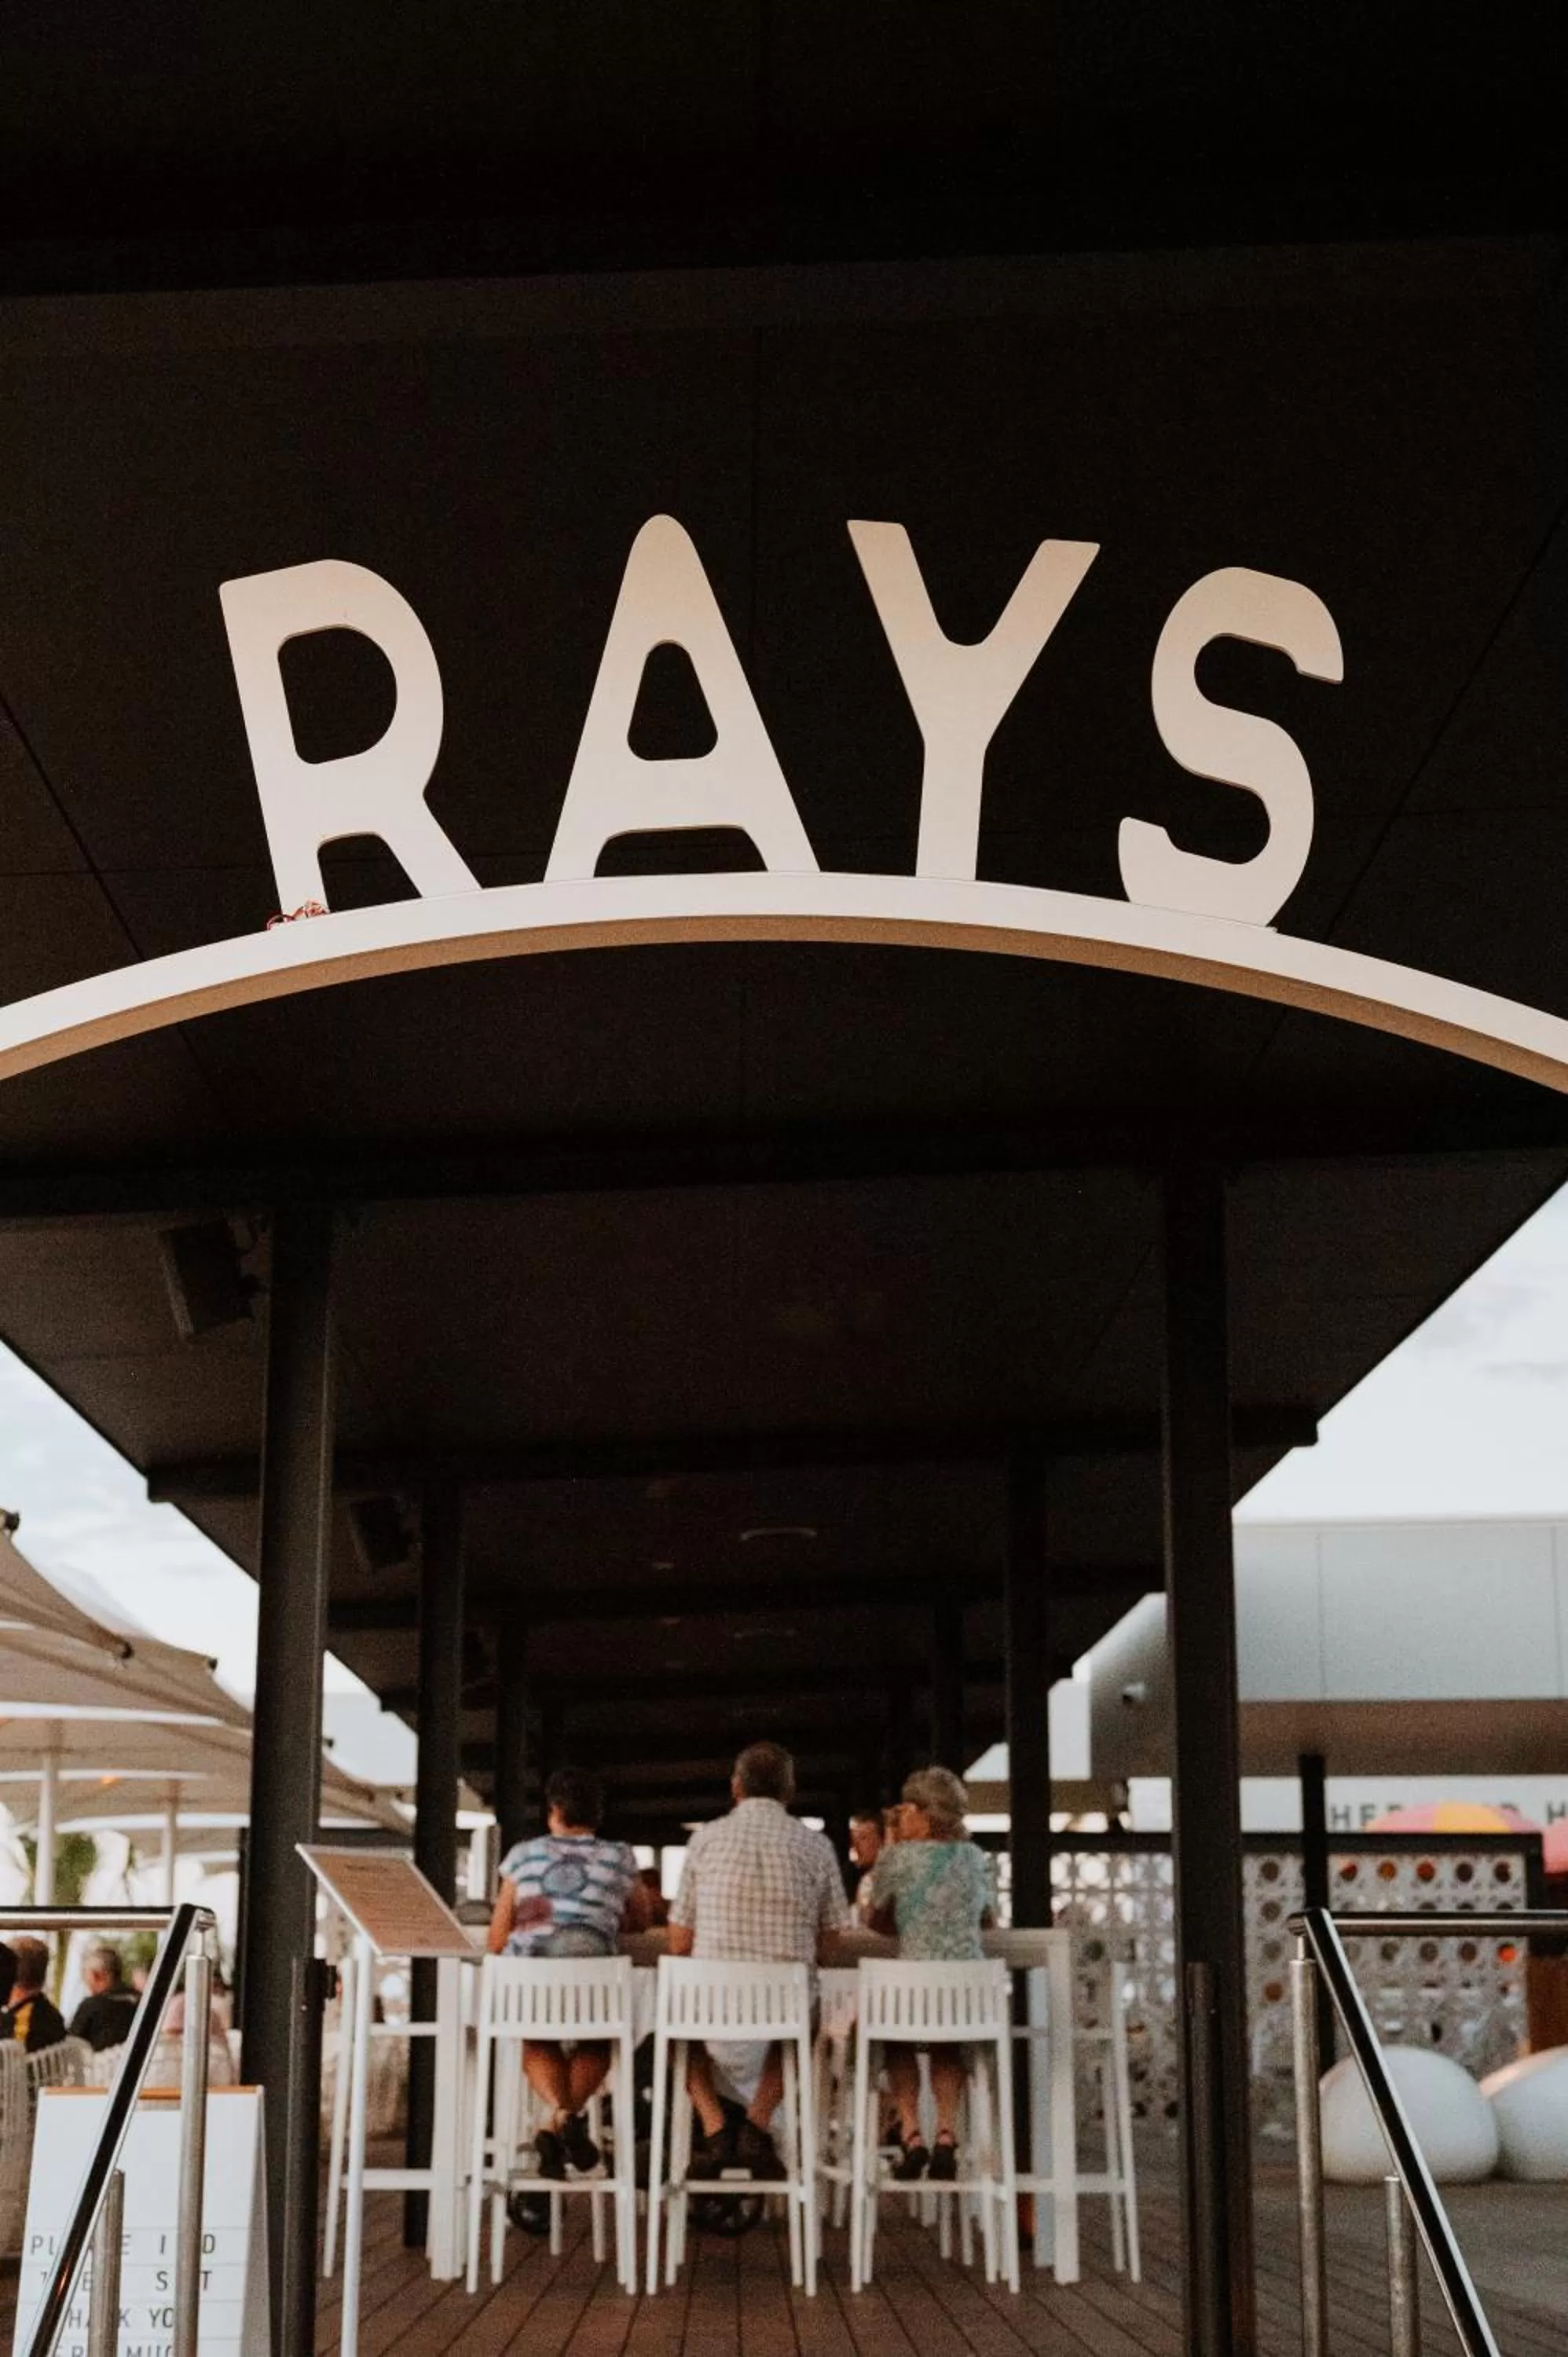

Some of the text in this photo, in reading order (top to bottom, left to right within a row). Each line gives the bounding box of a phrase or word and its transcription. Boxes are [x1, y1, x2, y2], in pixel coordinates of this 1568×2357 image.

[219, 514, 1344, 928] RAYS
[30, 2234, 132, 2256] PLE
[156, 2270, 214, 2292] ST
